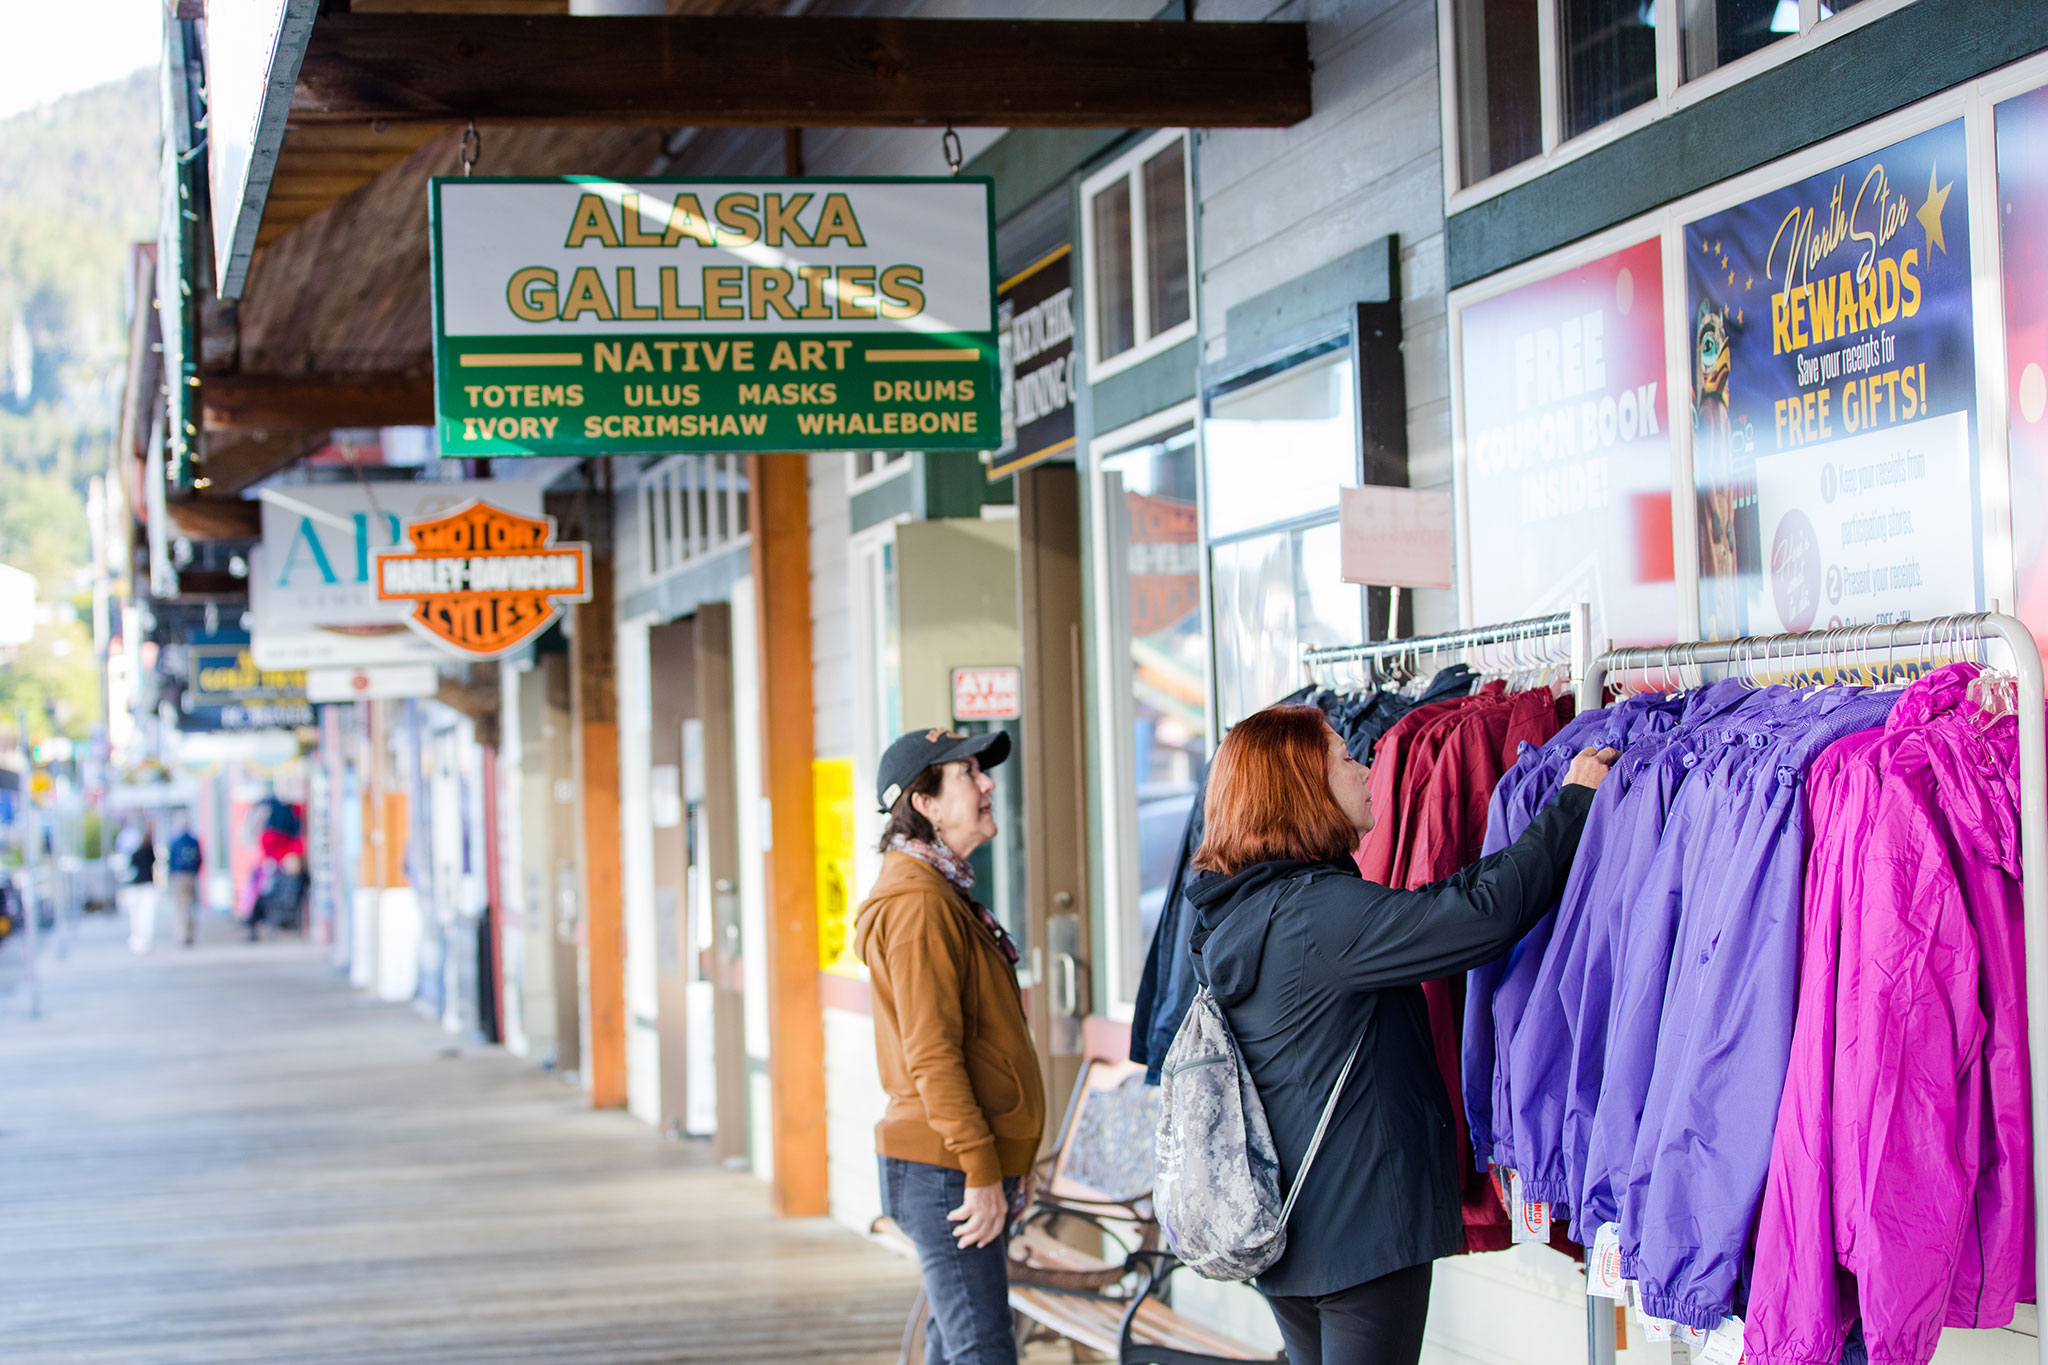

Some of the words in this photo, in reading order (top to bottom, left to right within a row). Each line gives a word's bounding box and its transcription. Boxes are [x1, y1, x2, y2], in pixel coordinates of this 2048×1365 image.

[564, 193, 866, 248] ALASKA
[1767, 174, 1848, 307] North
[1850, 163, 1909, 285] Star
[507, 265, 925, 322] GALLERIES
[1771, 248, 1922, 355] REWARDS
[593, 341, 754, 372] NATIVE
[769, 340, 852, 371] ART
[1515, 309, 1605, 412] FREE
[1797, 353, 1819, 387] Save
[1820, 351, 1841, 386] your
[1842, 334, 1880, 374] receipts
[1880, 330, 1896, 364] for
[464, 384, 584, 408] TOTEMS
[624, 384, 700, 407] ULUS
[739, 382, 837, 405] MASKS
[874, 380, 975, 402] DRUMS
[1775, 388, 1832, 449] FREE
[1842, 362, 1927, 433] GIFTS!
[463, 416, 559, 440] IVORY
[584, 413, 768, 438] SCRIMSHAW
[797, 411, 978, 436] WHALEBONE
[1475, 408, 1575, 476] COUPON
[1583, 382, 1659, 451] BOOK
[1520, 456, 1608, 523] INSIDE!
[1839, 464, 1857, 496] Keep
[1858, 464, 1874, 496] your
[1876, 451, 1906, 488] receipts
[1907, 449, 1925, 480] from
[416, 513, 542, 551] MOTOR
[1841, 510, 1887, 551] participating
[1888, 504, 1915, 537] stores.
[382, 554, 578, 594] HARLEY-DAVIDSON
[1844, 561, 1871, 597] Present
[1872, 567, 1888, 598] your
[1890, 555, 1923, 592] receipts.
